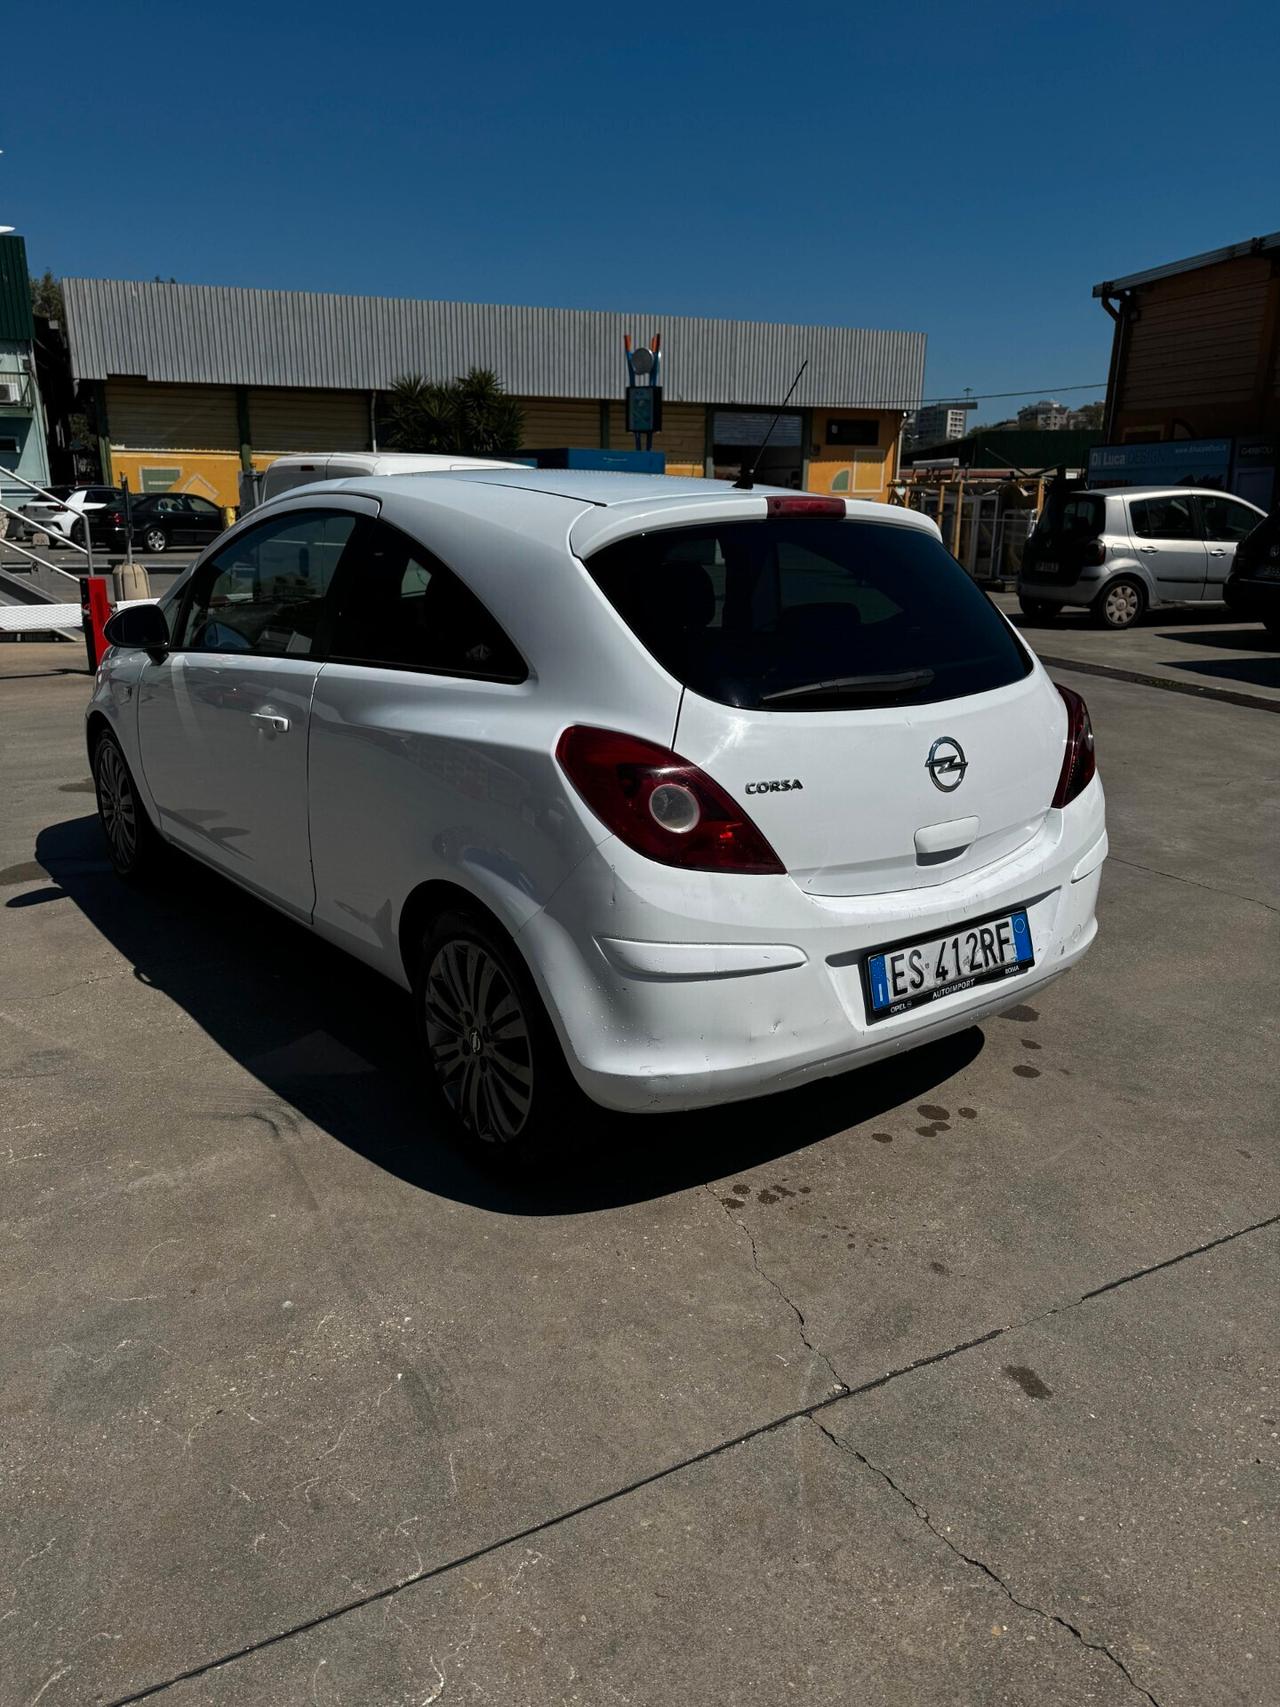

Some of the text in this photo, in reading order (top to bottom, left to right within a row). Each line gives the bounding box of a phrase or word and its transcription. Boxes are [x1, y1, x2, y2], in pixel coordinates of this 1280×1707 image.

[1091, 452, 1102, 466] Di
[1103, 451, 1126, 465] Luca
[745, 779, 803, 794] CORSA
[890, 921, 1010, 997] ES 412RF
[890, 1003, 907, 1014] OPEL
[932, 978, 976, 999] AUTOIMPORT
